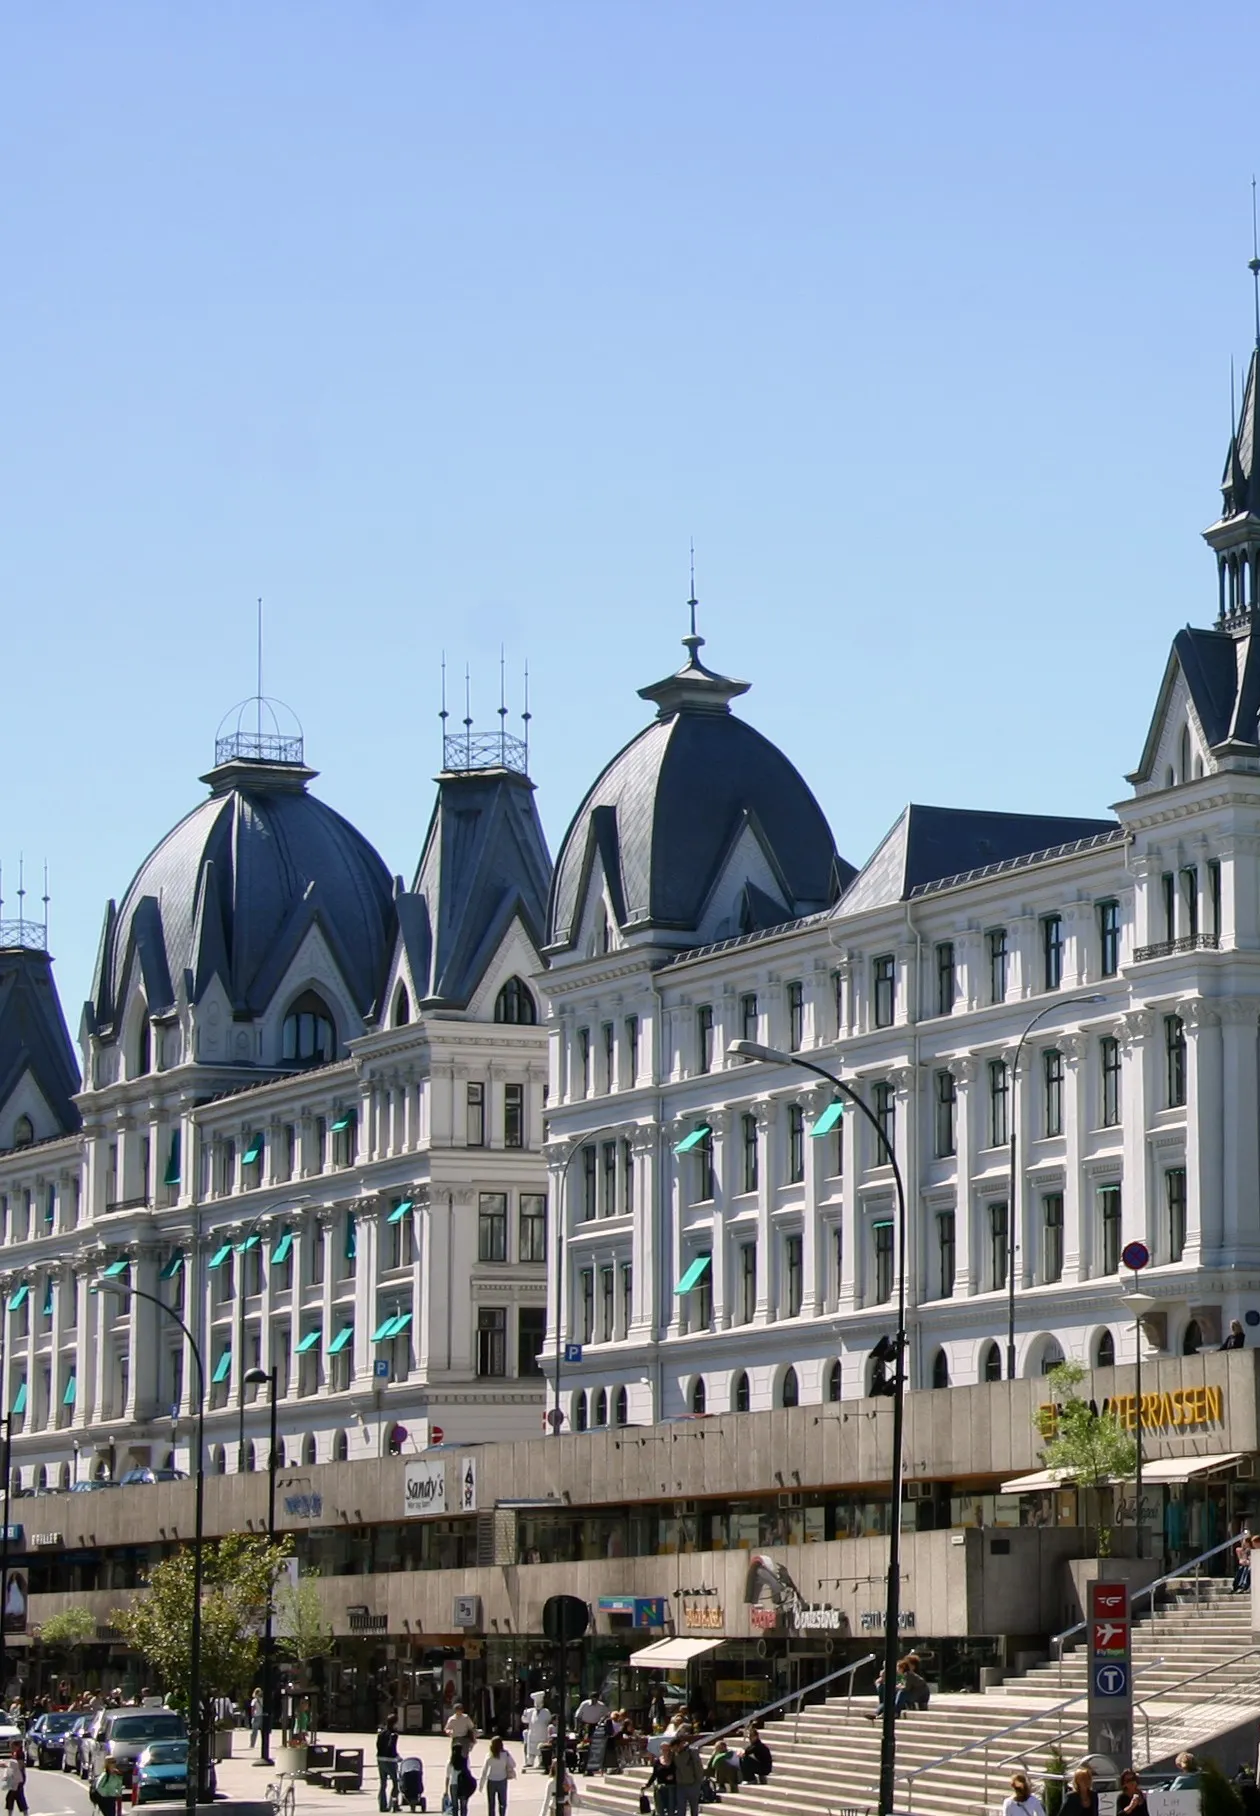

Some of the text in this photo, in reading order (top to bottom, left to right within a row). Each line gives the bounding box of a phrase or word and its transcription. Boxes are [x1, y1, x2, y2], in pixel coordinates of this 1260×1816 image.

[568, 1346, 578, 1360] P
[377, 1362, 386, 1375] P
[405, 1473, 444, 1502] Sandy's
